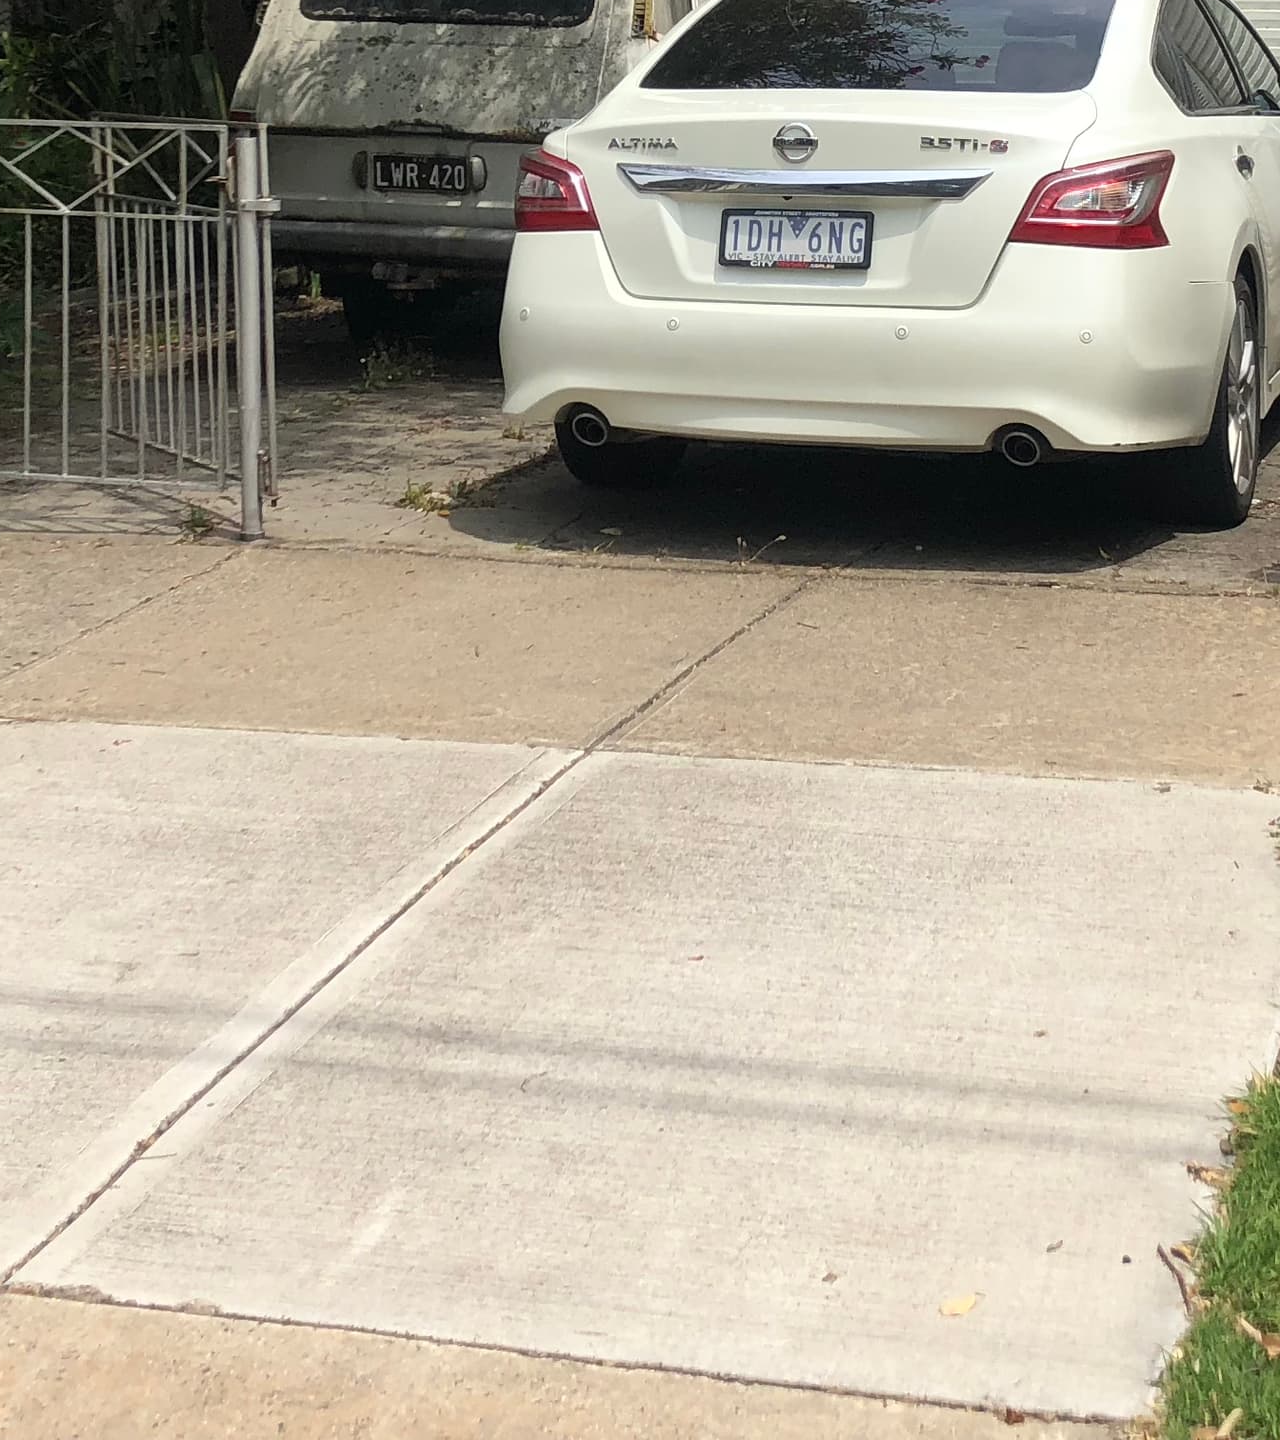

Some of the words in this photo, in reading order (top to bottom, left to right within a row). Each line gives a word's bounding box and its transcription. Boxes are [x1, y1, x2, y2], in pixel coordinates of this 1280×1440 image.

[607, 138, 679, 150] ALTIMA
[732, 219, 783, 253] 1DH
[808, 221, 865, 254] 6NG
[753, 252, 775, 261] STAY
[811, 254, 834, 263] STAY
[750, 260, 774, 268] CITY
